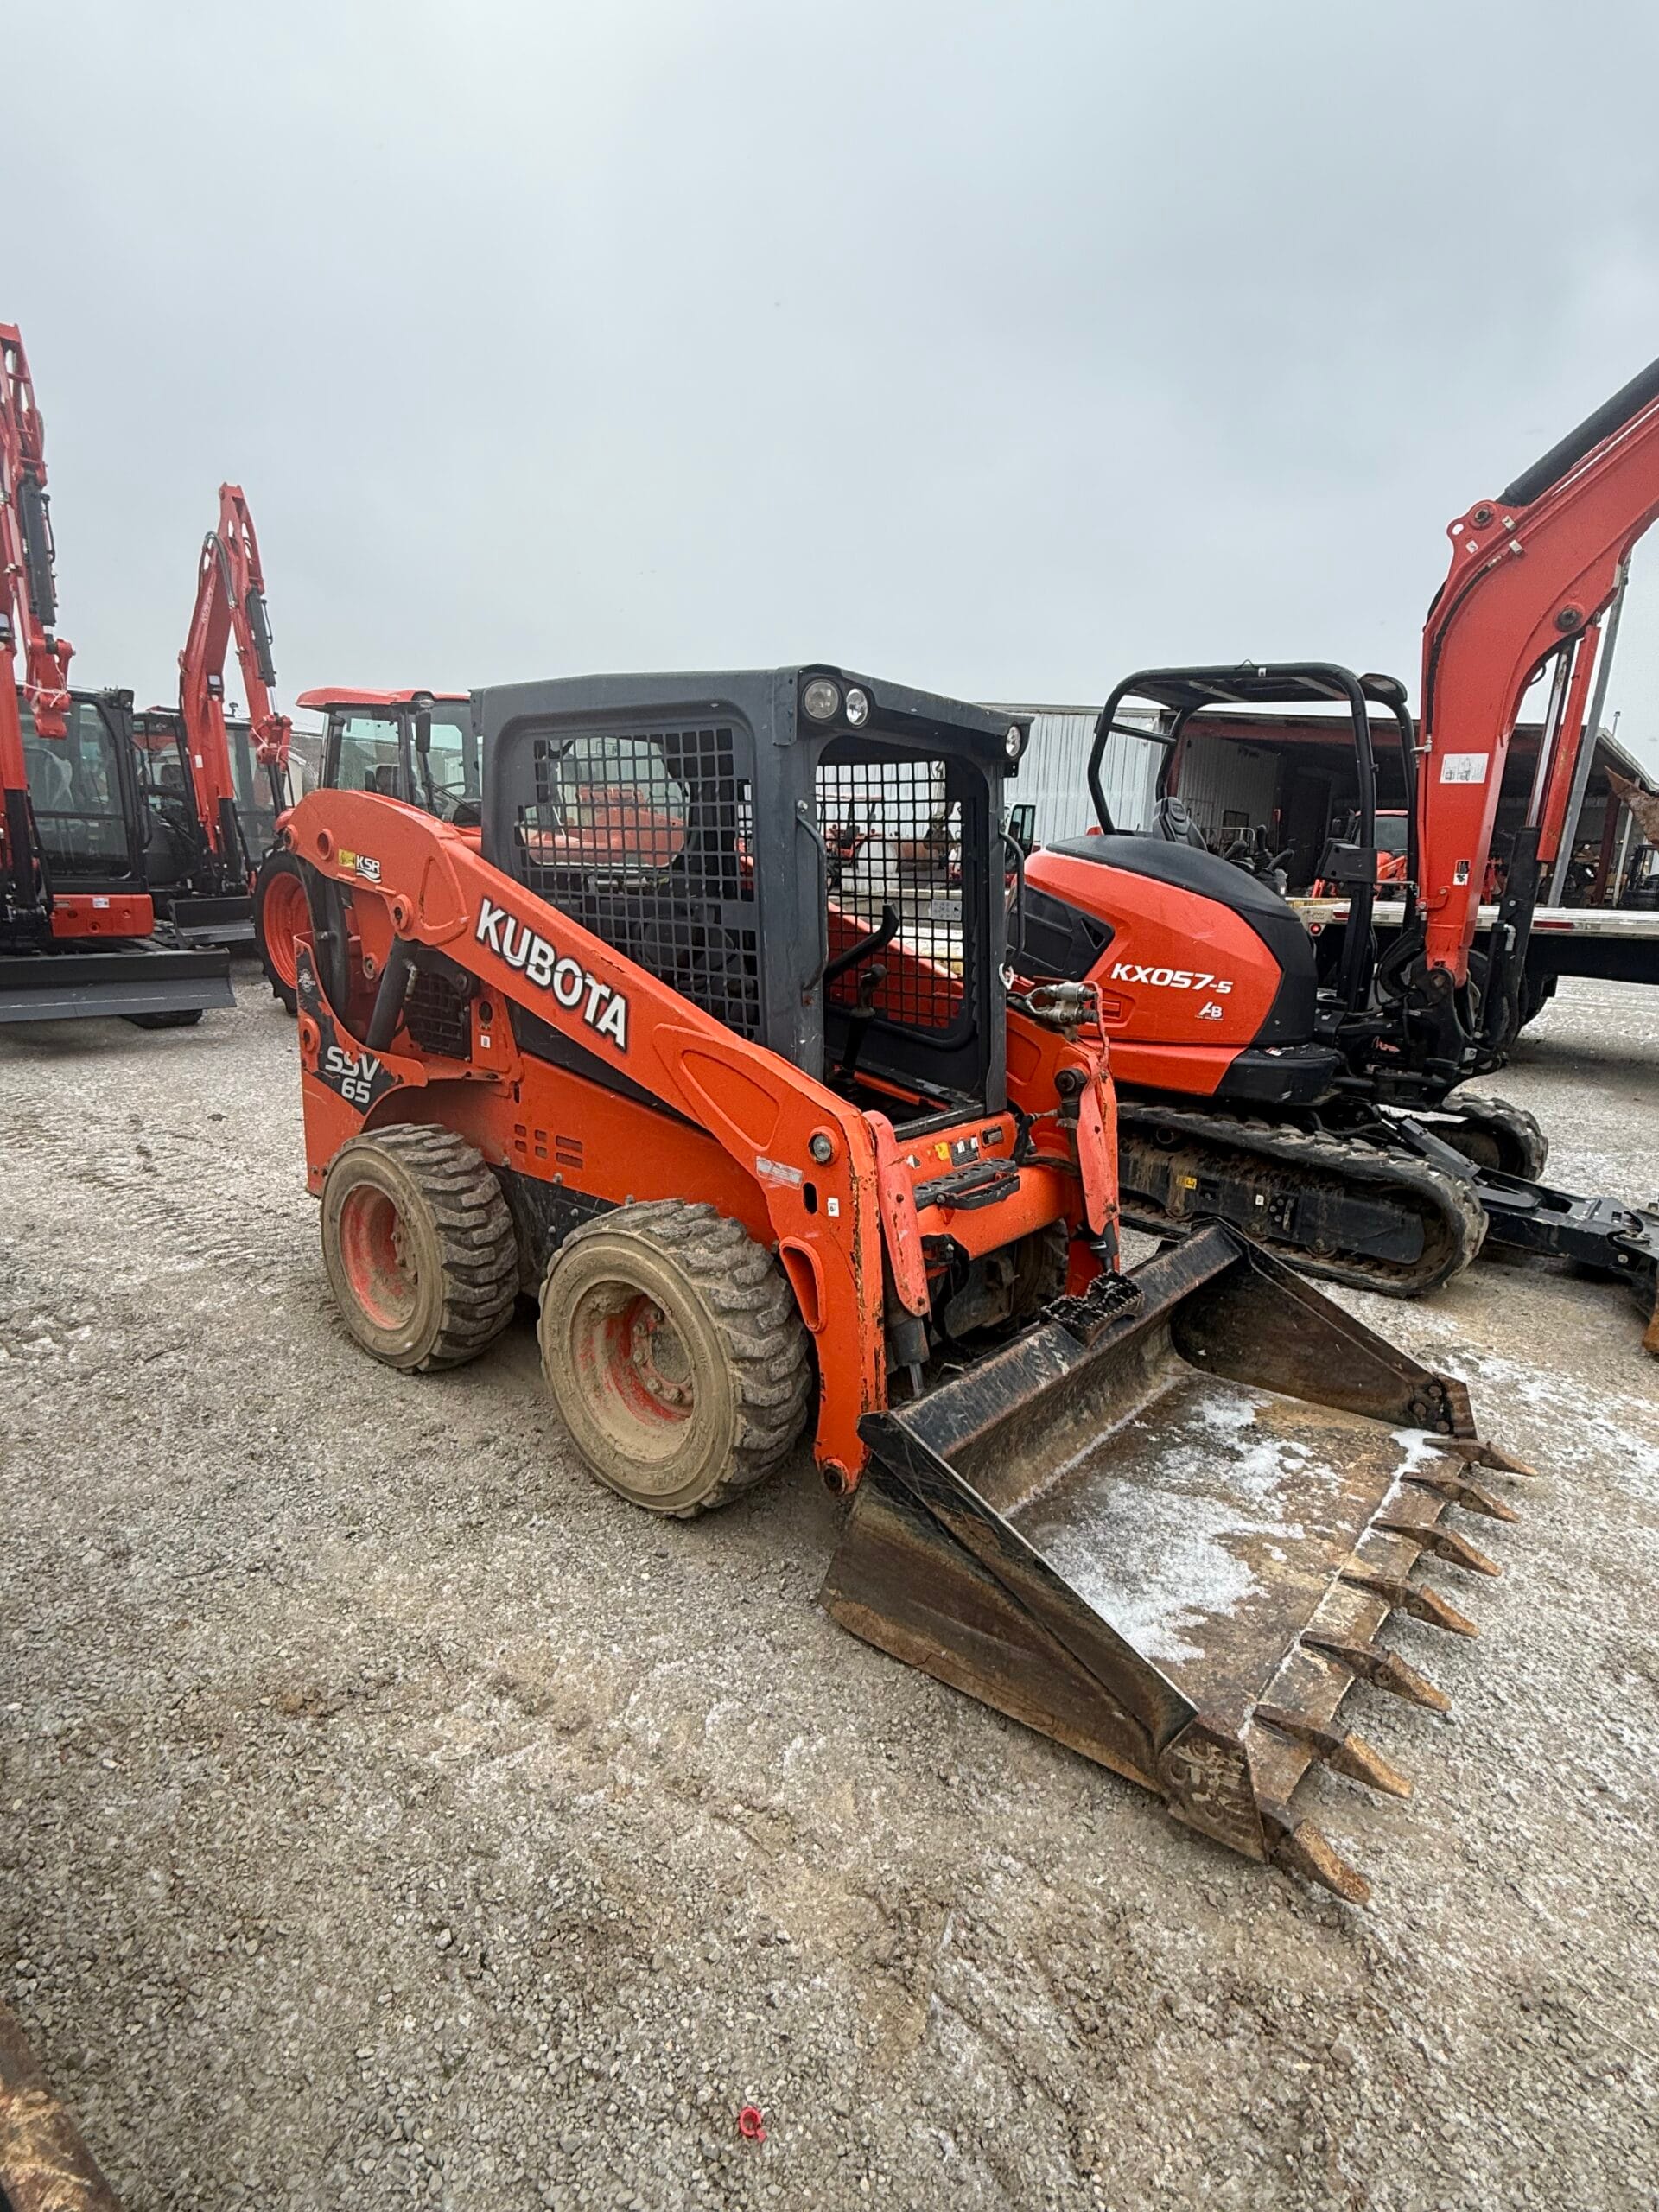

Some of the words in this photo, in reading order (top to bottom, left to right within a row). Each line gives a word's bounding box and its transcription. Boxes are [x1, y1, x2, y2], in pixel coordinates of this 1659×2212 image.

[356, 855, 381, 874] KSR
[476, 898, 626, 1050] KUBOTA
[1110, 963, 1234, 994] KX057-5
[1198, 1001, 1223, 1018] AB
[325, 1045, 381, 1081] SSV
[340, 1078, 372, 1104] 65
